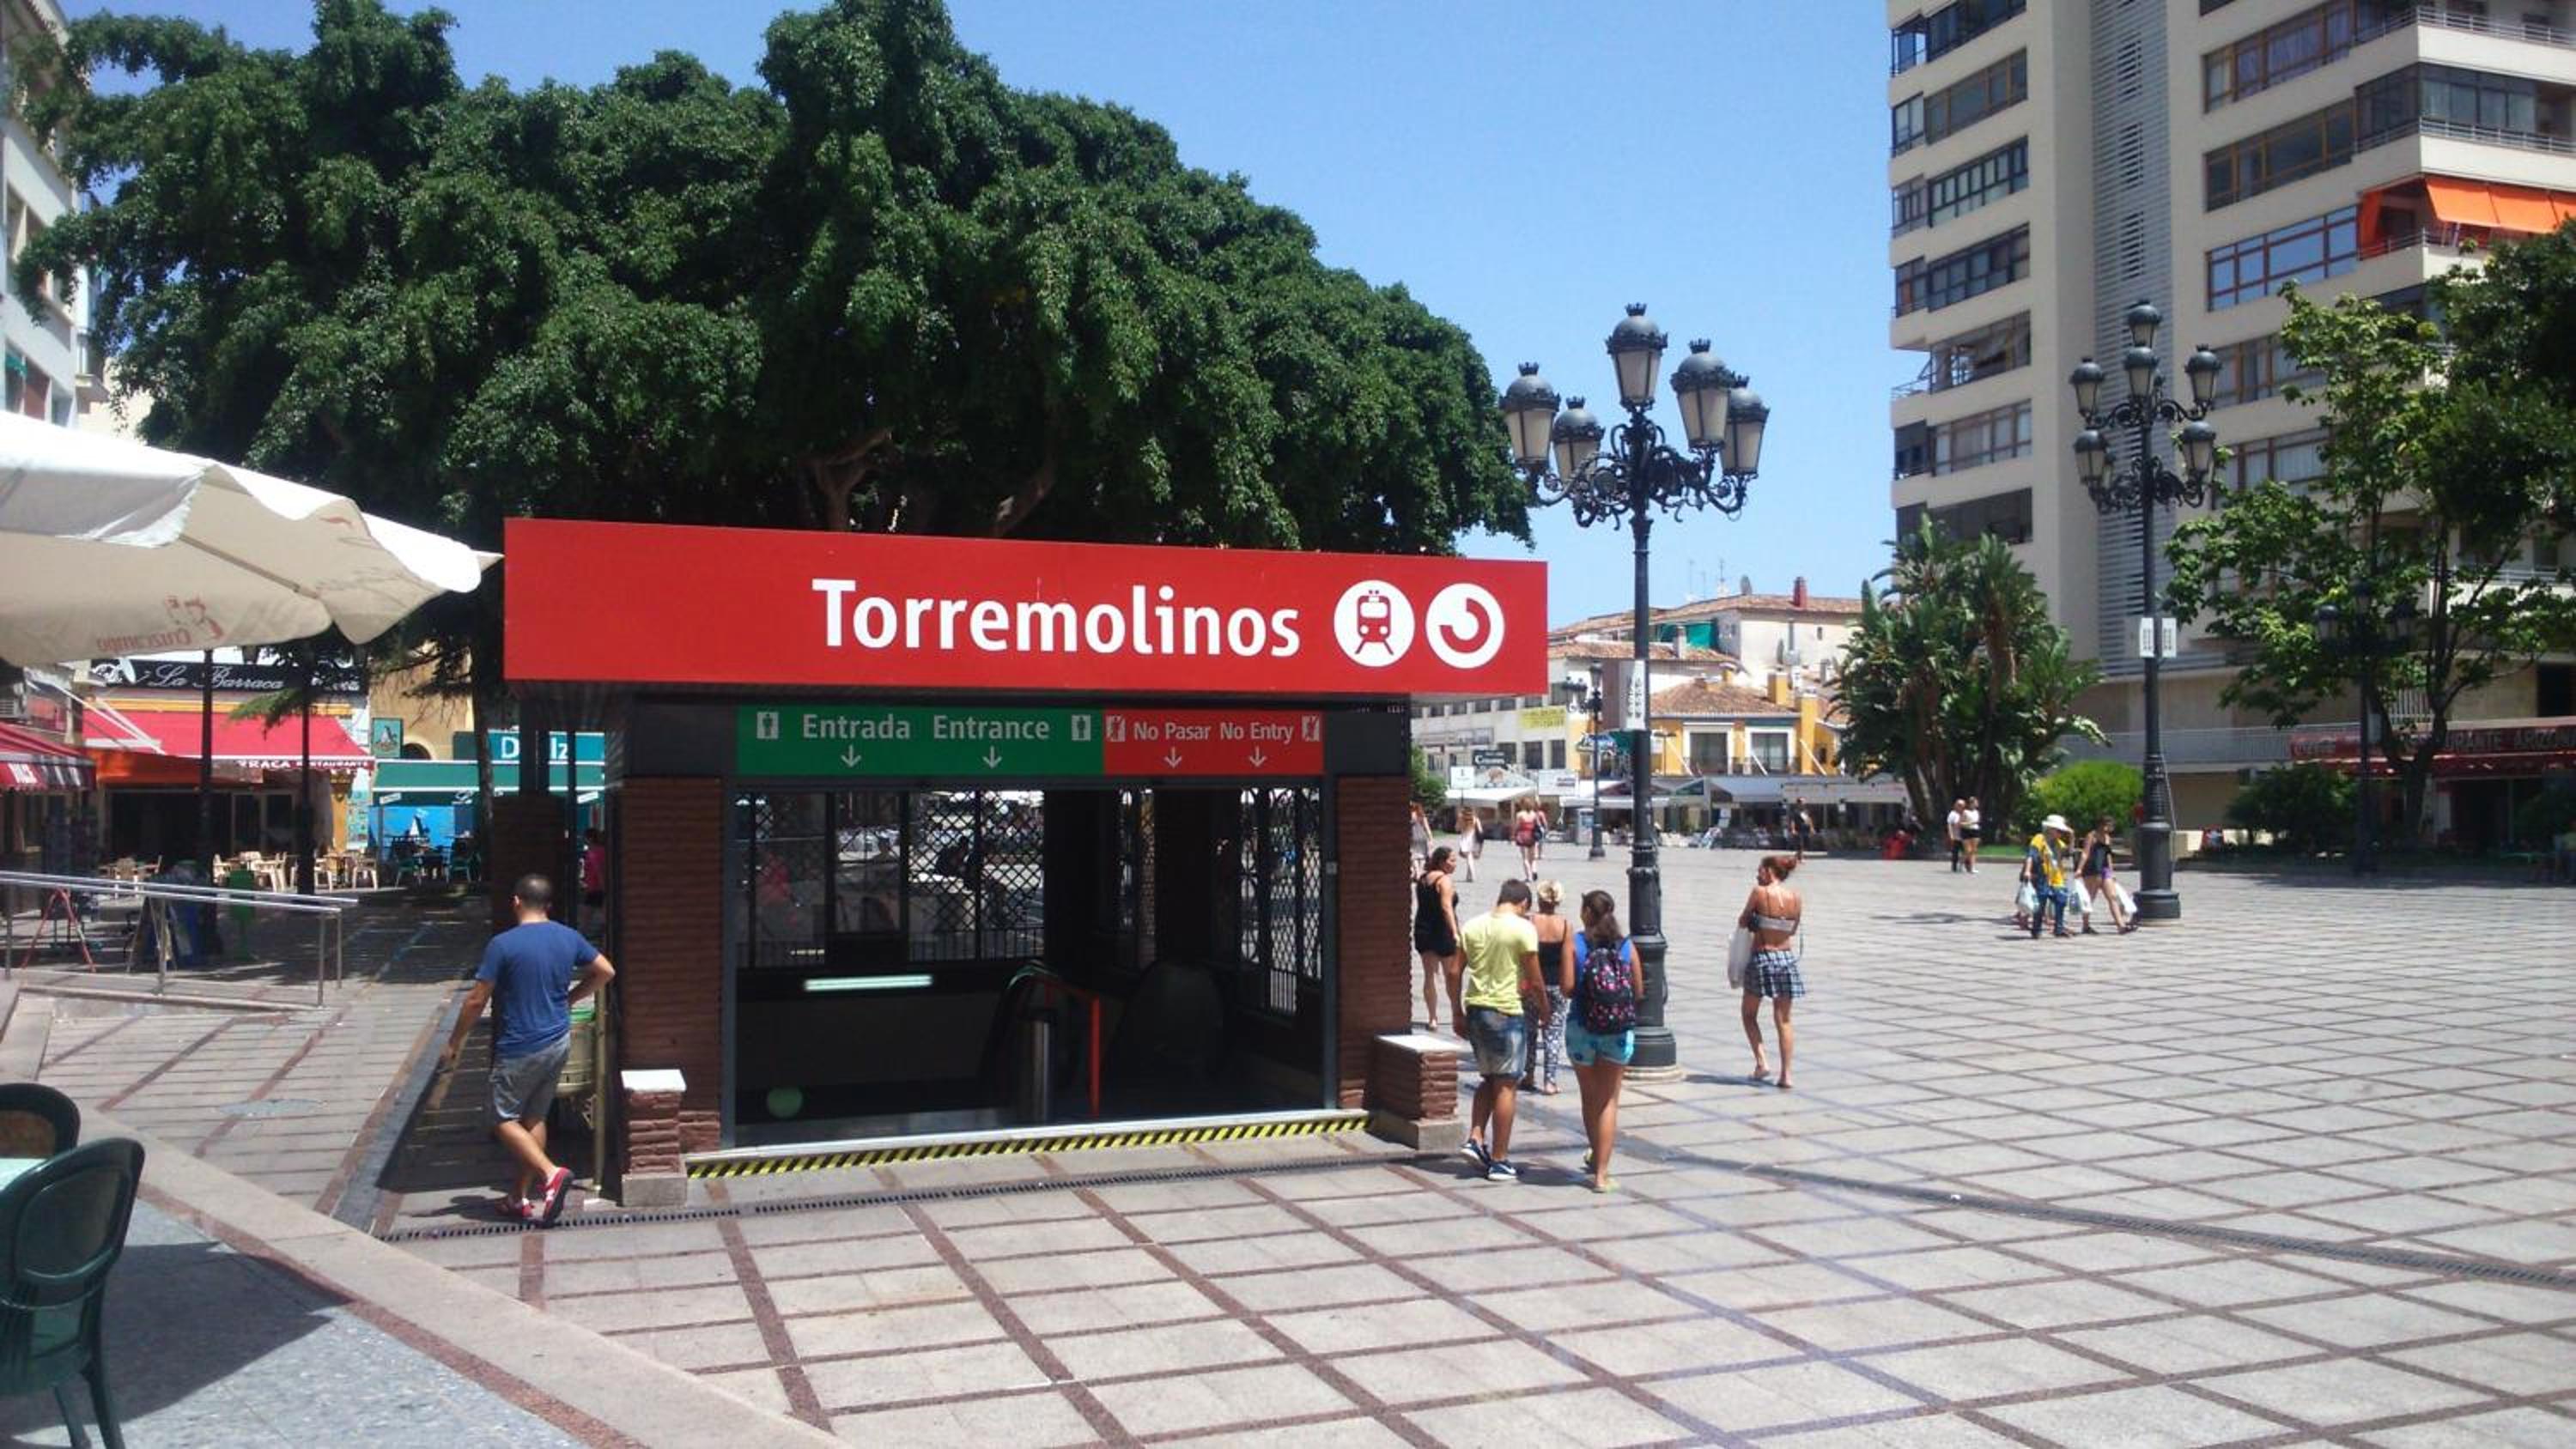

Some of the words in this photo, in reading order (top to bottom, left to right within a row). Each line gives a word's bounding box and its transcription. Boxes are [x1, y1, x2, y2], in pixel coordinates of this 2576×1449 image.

[811, 577, 1301, 658] Torremolinos
[802, 712, 911, 741] Entrada
[933, 714, 1050, 741] Entrance
[1133, 722, 1159, 740] No
[1164, 722, 1211, 741] Pasar
[1219, 722, 1244, 741] No
[1250, 722, 1294, 744] Entry
